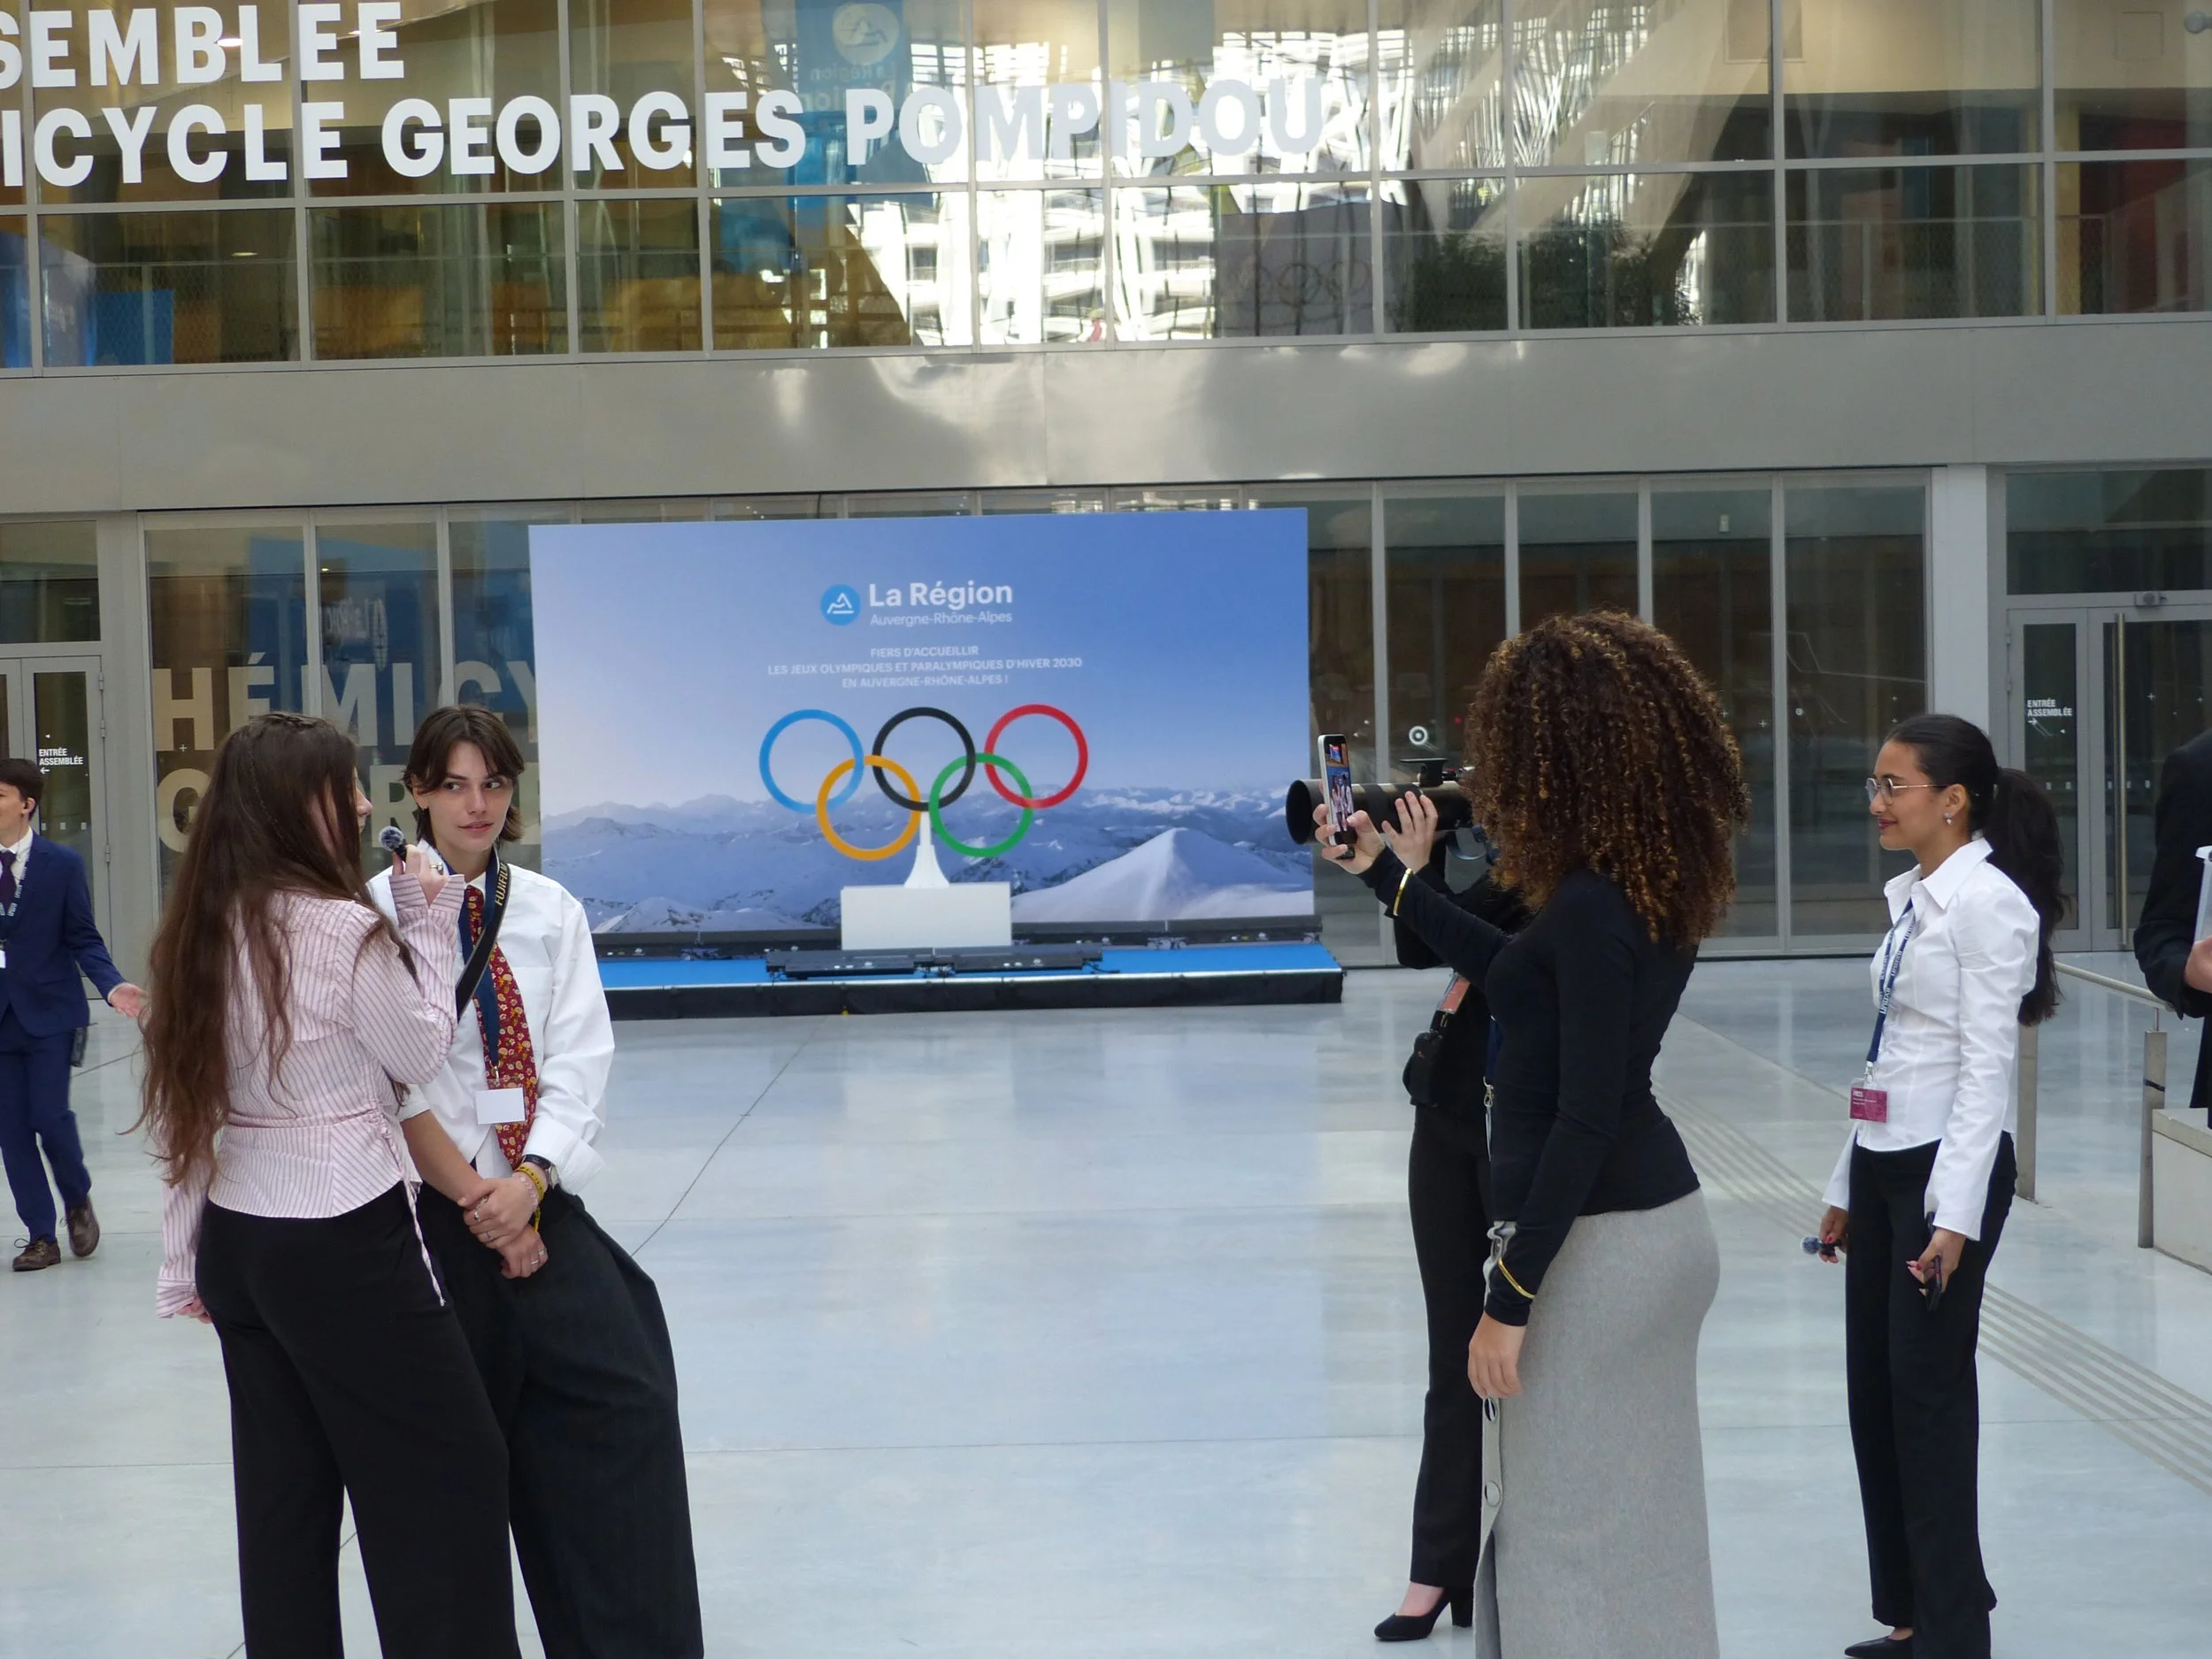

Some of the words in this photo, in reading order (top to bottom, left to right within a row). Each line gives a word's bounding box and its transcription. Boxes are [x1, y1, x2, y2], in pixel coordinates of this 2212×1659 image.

[382, 90, 806, 177] GEORGES
[847, 78, 1323, 165] POMPIDOU
[869, 583, 902, 607] La
[910, 580, 1013, 611] Région
[870, 611, 1013, 627] Auvergne-Rhône-Alpes
[870, 648, 901, 658] FIERS
[903, 646, 979, 657] D'ACCUEILLIR
[768, 664, 787, 675] LES
[790, 664, 818, 674] JEUX
[820, 662, 893, 674] OLYMPIQUES
[895, 662, 908, 672] ET
[910, 659, 1003, 672] PARALYMPIQUES
[1006, 658, 1050, 669] D'HIVER
[1053, 657, 1083, 668] 2030
[842, 678, 856, 688] EN
[860, 674, 1002, 687] AUVERGNE-RHÔNE-ALPES
[2027, 697, 2056, 708] ENTRÉE
[2027, 706, 2073, 717] ASSEMBLÉE
[39, 747, 68, 757] ENTRÉE
[39, 755, 84, 765] ASSEMBLÉE
[495, 862, 509, 906] FUJIFILM
